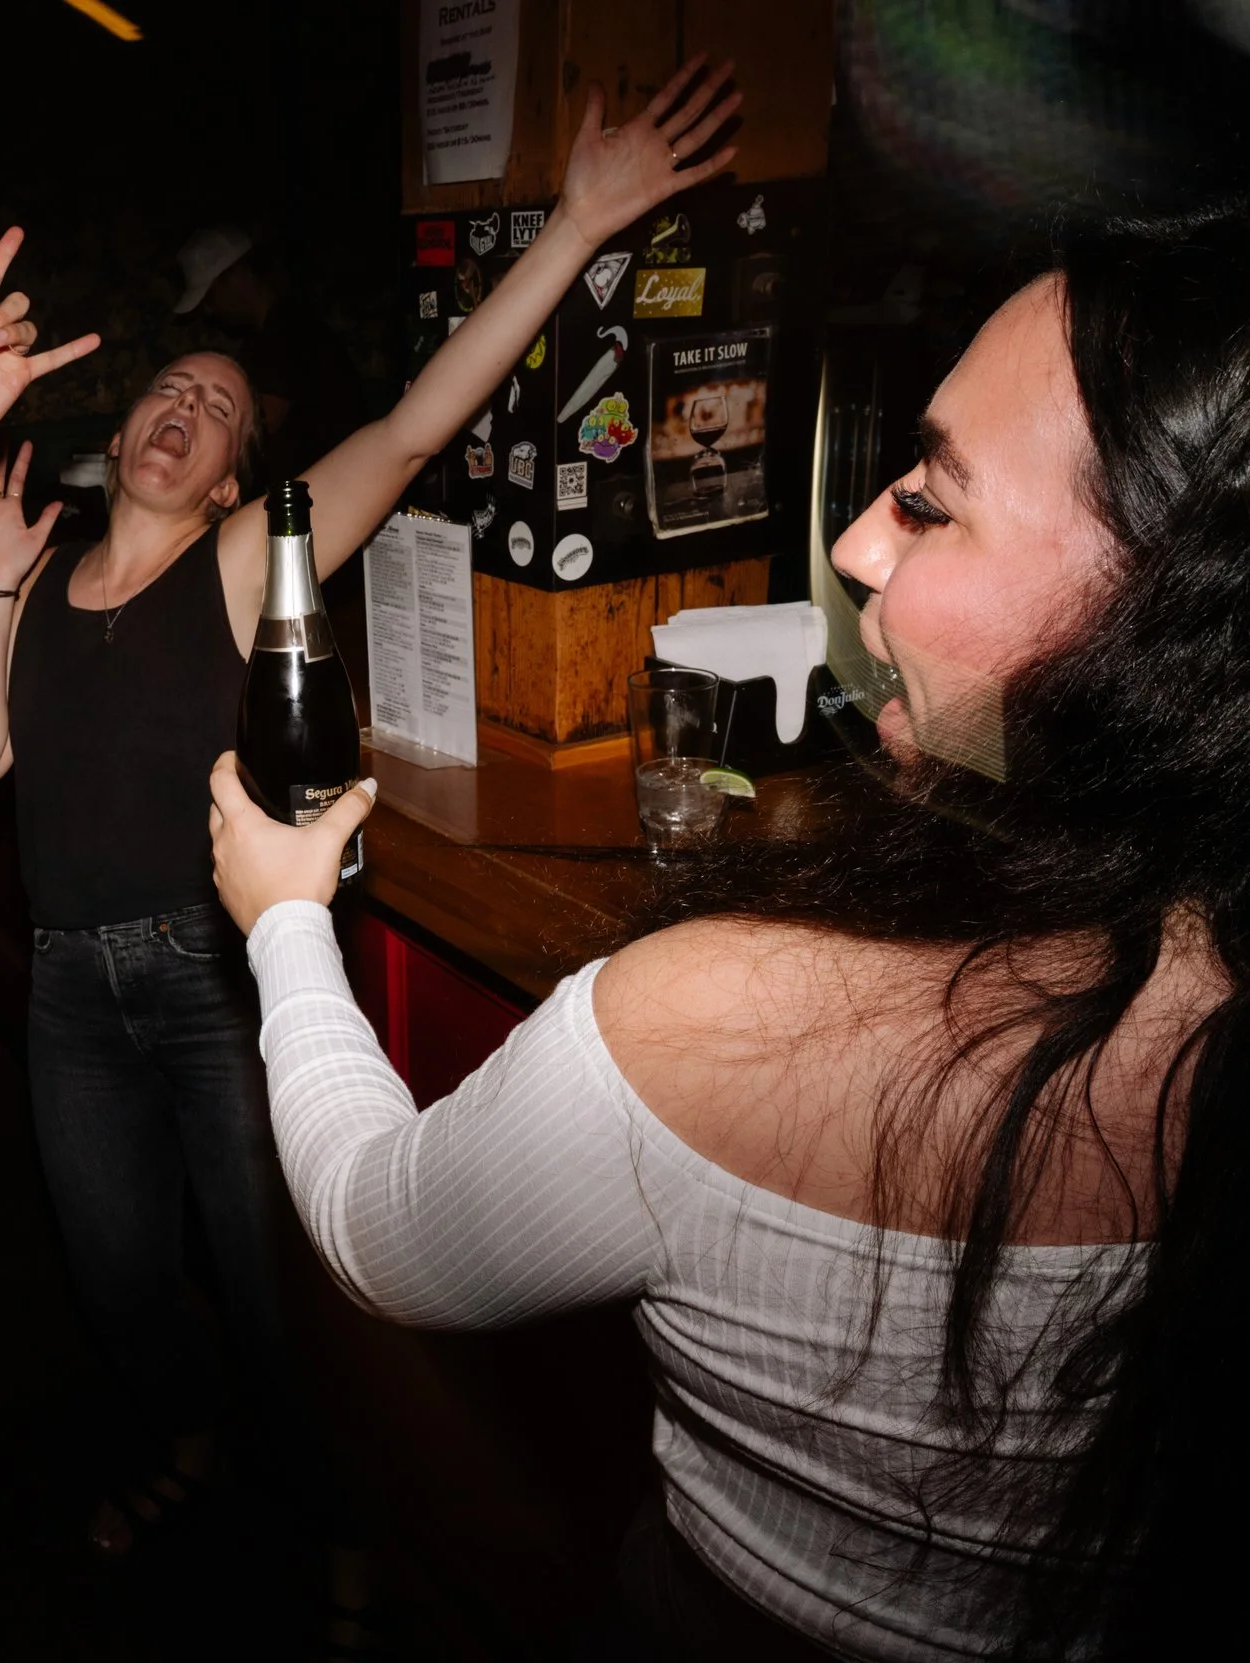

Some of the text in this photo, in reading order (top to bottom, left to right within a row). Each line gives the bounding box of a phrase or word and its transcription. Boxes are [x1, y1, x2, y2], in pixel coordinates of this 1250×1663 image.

[439, 0, 496, 27] RENTALS
[673, 348, 701, 367] TAKE
[704, 346, 716, 362] IT
[717, 342, 748, 361] SLOW
[510, 456, 534, 479] UBC
[305, 785, 343, 801] Segura
